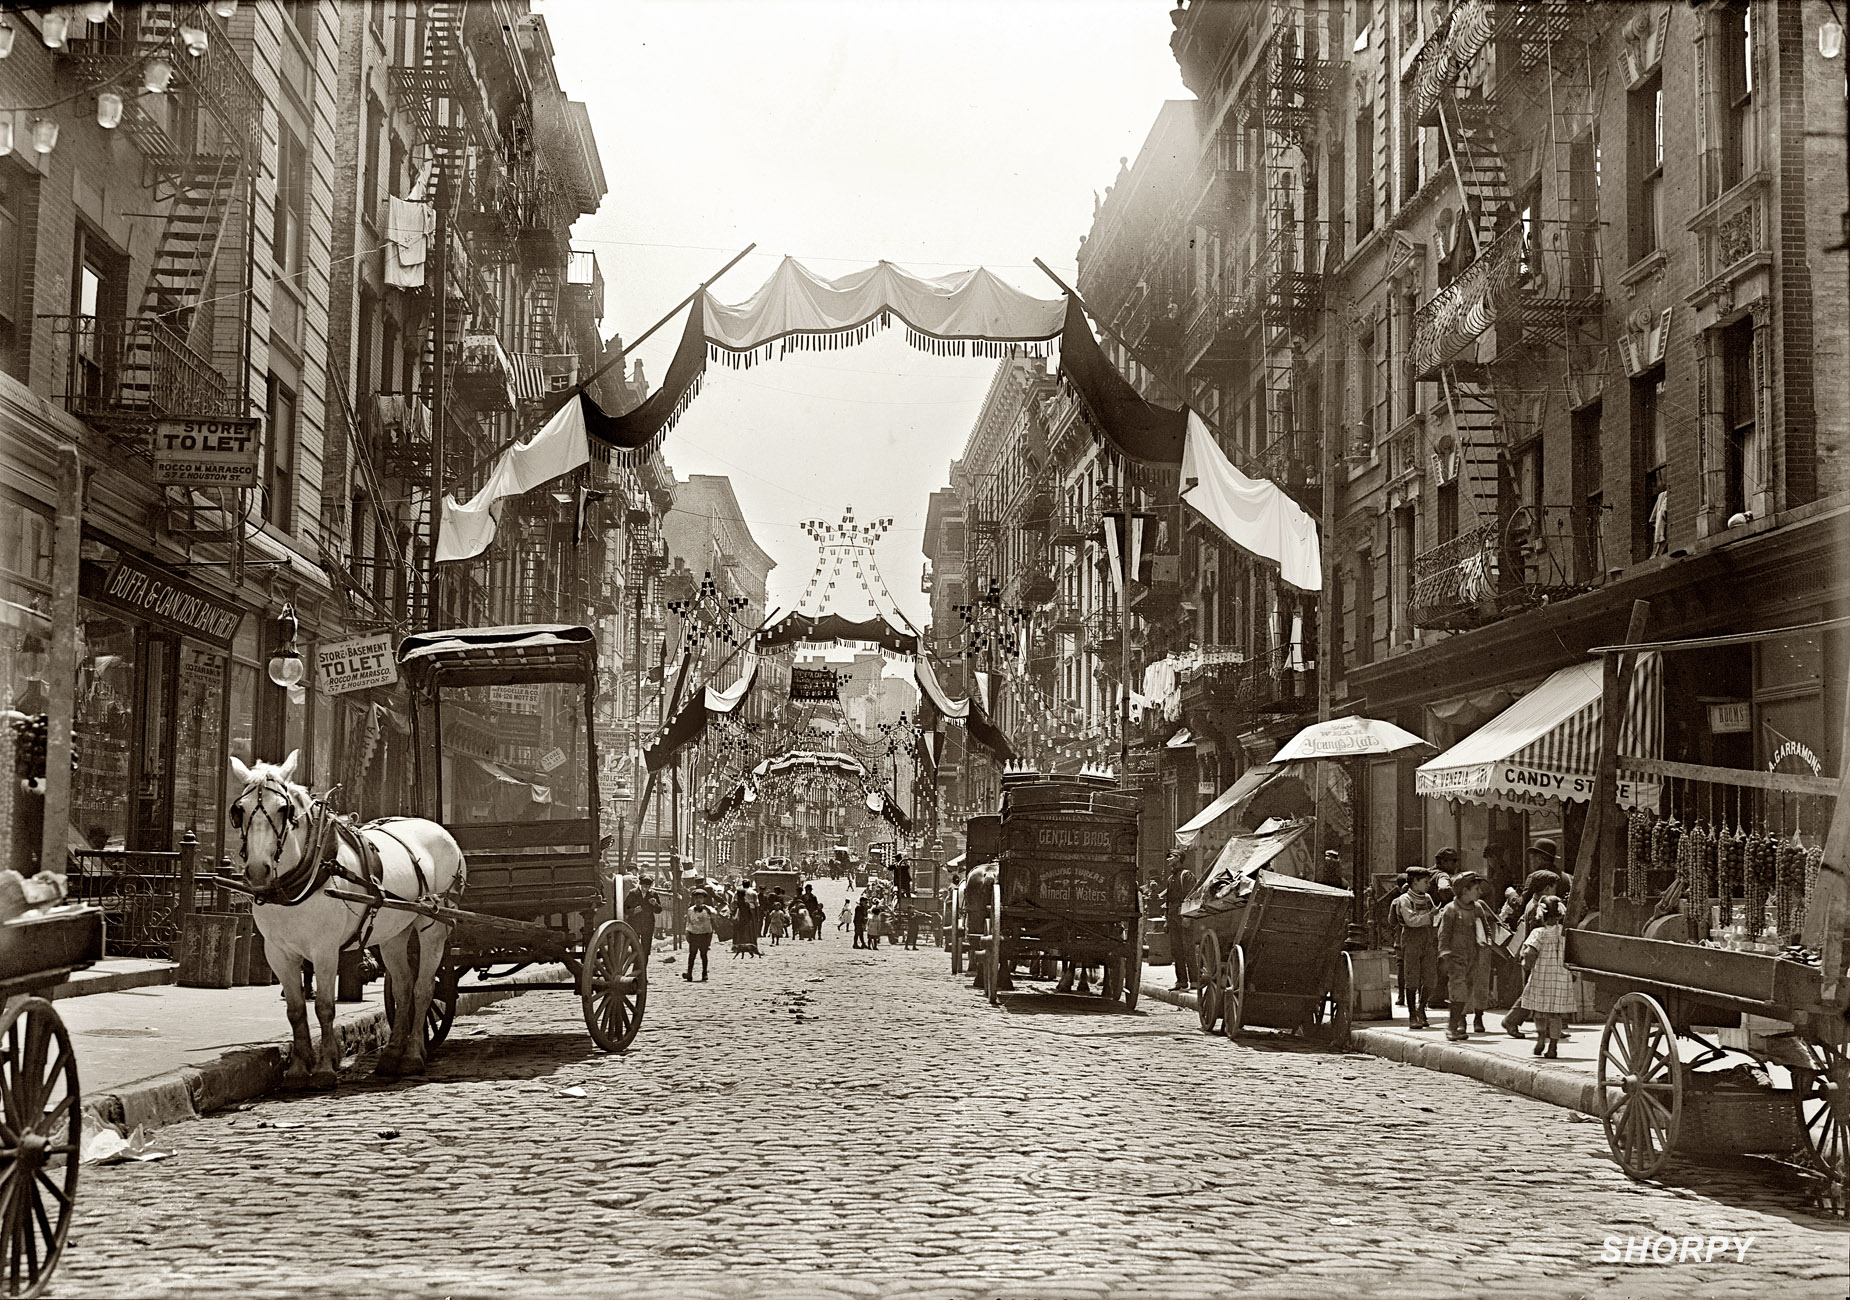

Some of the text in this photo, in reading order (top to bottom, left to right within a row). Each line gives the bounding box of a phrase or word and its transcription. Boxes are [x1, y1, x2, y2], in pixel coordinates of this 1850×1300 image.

[184, 422, 245, 435] STORE
[163, 433, 252, 453] TO LET
[158, 463, 252, 474] ROCCO M. MARASCO
[163, 471, 177, 479] 57
[187, 472, 227, 481] HOUSTON
[229, 474, 241, 482] ST.
[109, 565, 150, 605] BUFFA
[144, 581, 161, 609] &
[194, 602, 241, 640] BANCHIERI
[319, 642, 387, 663] STORE BASEMENT
[321, 653, 385, 678] TO LET
[328, 684, 339, 692] 57
[347, 679, 380, 689] HOUSTON
[329, 675, 351, 685] ROCCO
[1718, 706, 1744, 723] ROOMS
[542, 751, 561, 763] STORE
[1774, 741, 1822, 777] GARRAMONE
[1504, 768, 1565, 789] CANDY
[1573, 778, 1631, 799] STE
[1039, 828, 1079, 846] GENTILE
[1039, 883, 1107, 902] Mineral Waters
